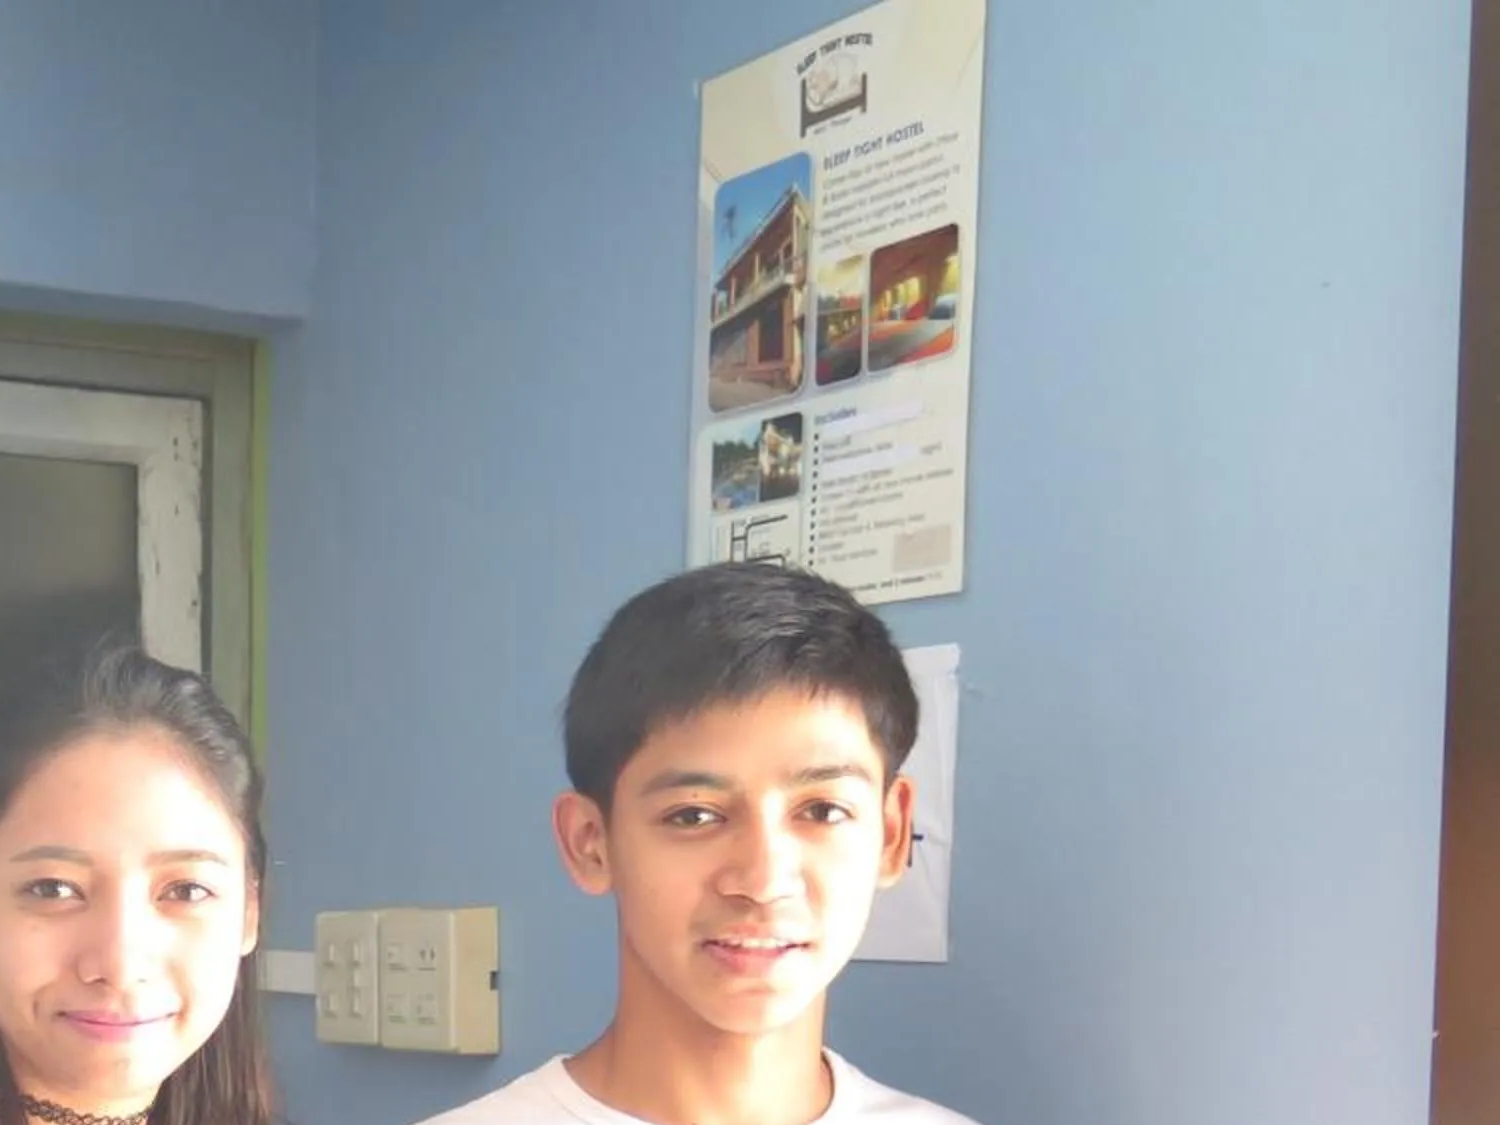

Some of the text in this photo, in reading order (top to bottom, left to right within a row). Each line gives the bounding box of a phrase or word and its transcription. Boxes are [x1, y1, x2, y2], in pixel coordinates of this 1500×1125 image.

[823, 121, 925, 172] SLEEP TIGHT HOSTEL
